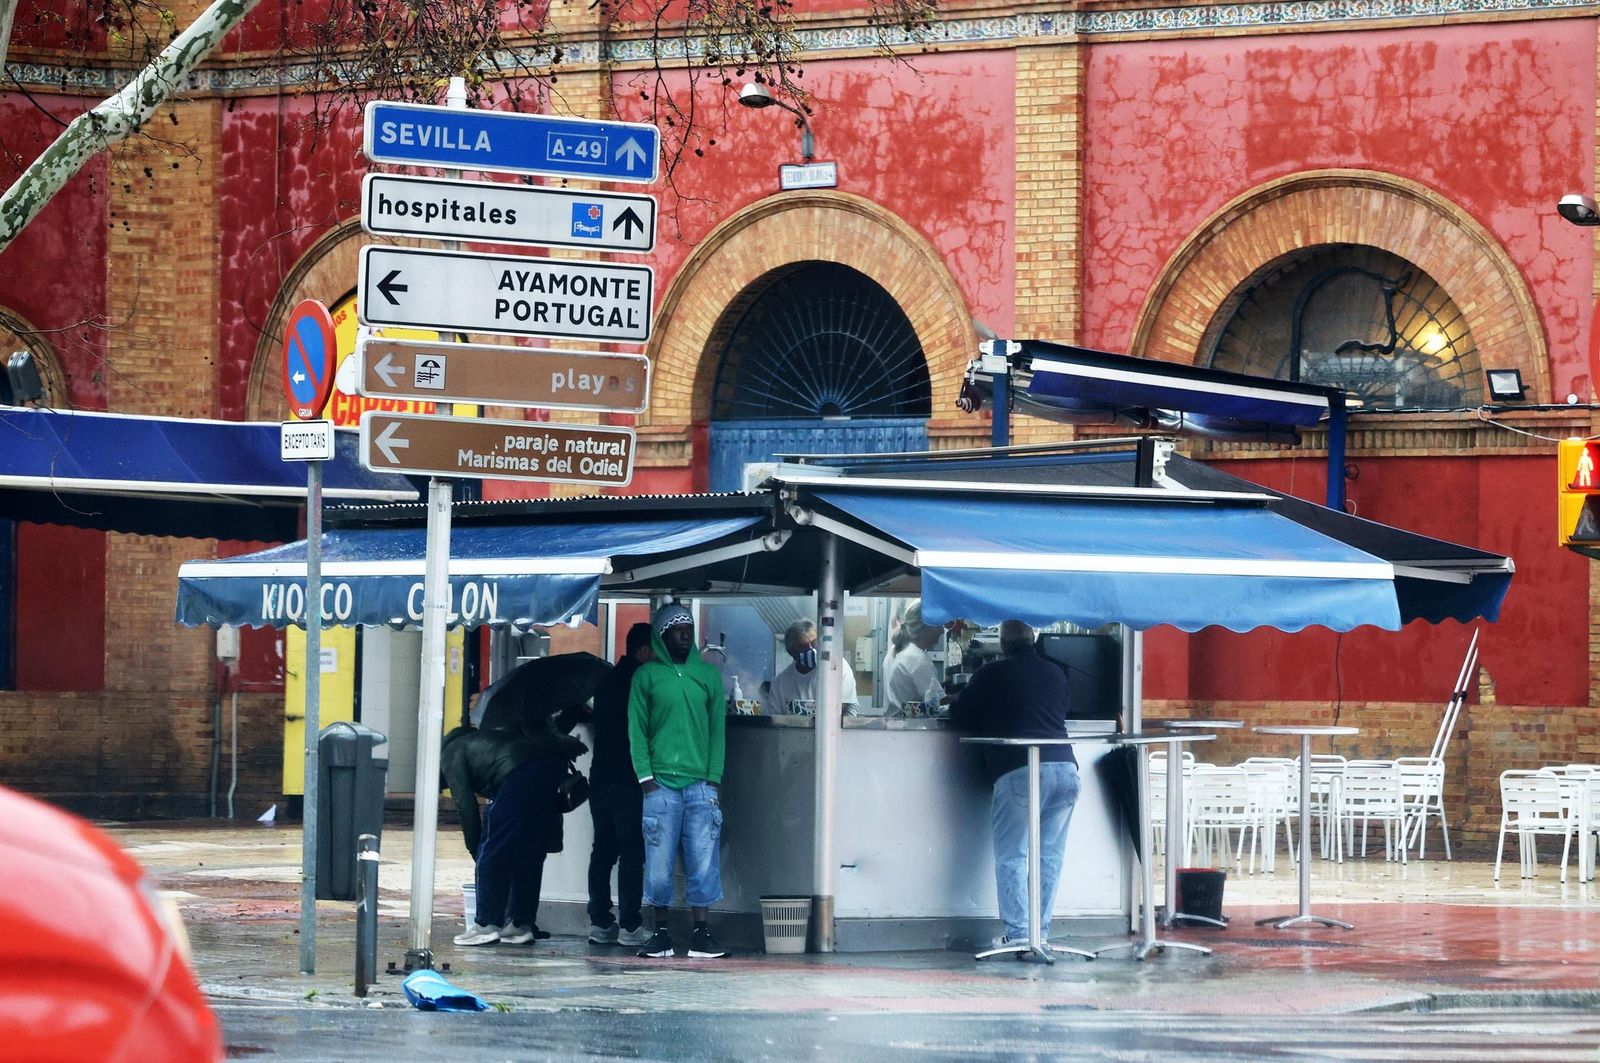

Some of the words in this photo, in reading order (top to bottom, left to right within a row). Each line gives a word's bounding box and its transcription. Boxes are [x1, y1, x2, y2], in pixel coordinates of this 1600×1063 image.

[380, 121, 492, 153] SEVILLA
[551, 138, 603, 159] A-49
[378, 193, 517, 225] hospitales
[497, 270, 641, 300] AYAMONTE
[495, 298, 640, 329] PORTUGAL
[551, 368, 637, 395] playas
[284, 433, 310, 449] EXCEPTO
[310, 432, 326, 449] TAXIS
[504, 434, 559, 454] paraje
[565, 437, 626, 456] natural
[457, 449, 539, 471] Marismas
[546, 456, 573, 473] del
[579, 457, 624, 476] Odiel
[261, 582, 353, 620] KIOCO
[406, 581, 498, 621] CLON
